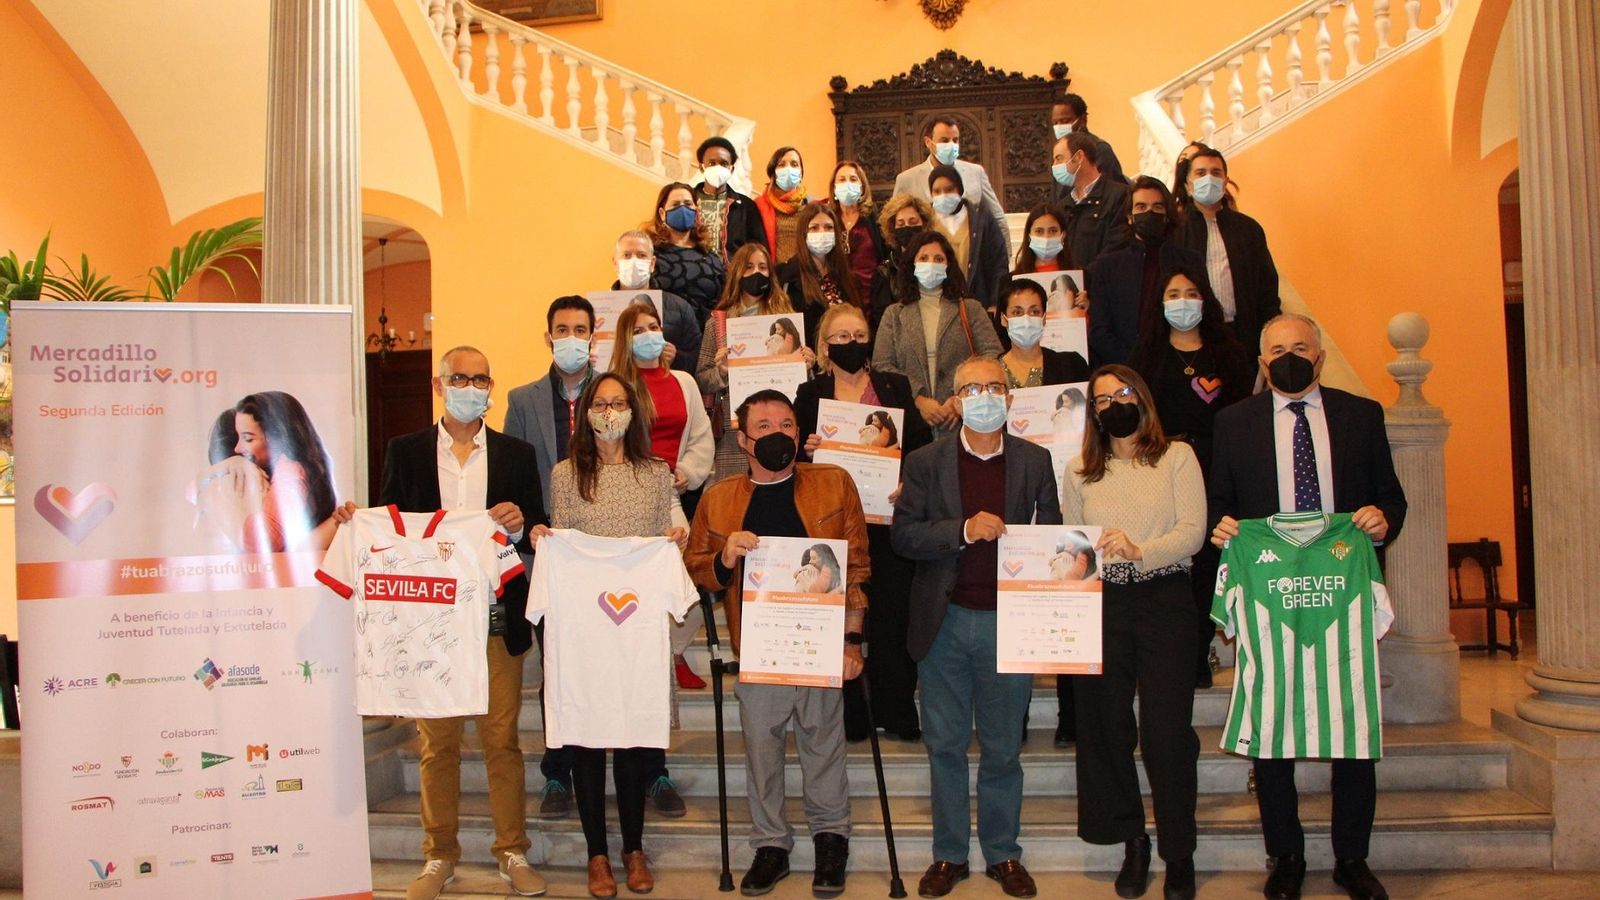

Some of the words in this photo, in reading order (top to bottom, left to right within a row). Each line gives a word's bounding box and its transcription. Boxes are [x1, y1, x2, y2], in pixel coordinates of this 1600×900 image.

[30, 344, 157, 362] Mercadillo
[39, 405, 106, 419] Segunda
[111, 404, 164, 417] Edición
[365, 578, 429, 598] SEVILLA
[432, 582, 455, 600] FC
[1267, 575, 1345, 594] FOREVER
[1282, 592, 1333, 609] GREEN
[110, 613, 120, 623] A
[124, 610, 180, 622] beneficio
[183, 609, 199, 620] de
[202, 608, 213, 618] la
[216, 605, 263, 617] Infancia
[266, 607, 274, 617] y
[97, 626, 153, 640] Juventud
[157, 623, 210, 636] Tutelada
[213, 624, 221, 635] y
[224, 620, 287, 633] Extutelada
[228, 664, 260, 676] afasode
[68, 678, 98, 688] ACRE
[160, 727, 218, 740] Colaboran:
[289, 747, 320, 757] utilweb
[71, 802, 108, 811] ROSMAT
[172, 821, 232, 835] Patrocinan:
